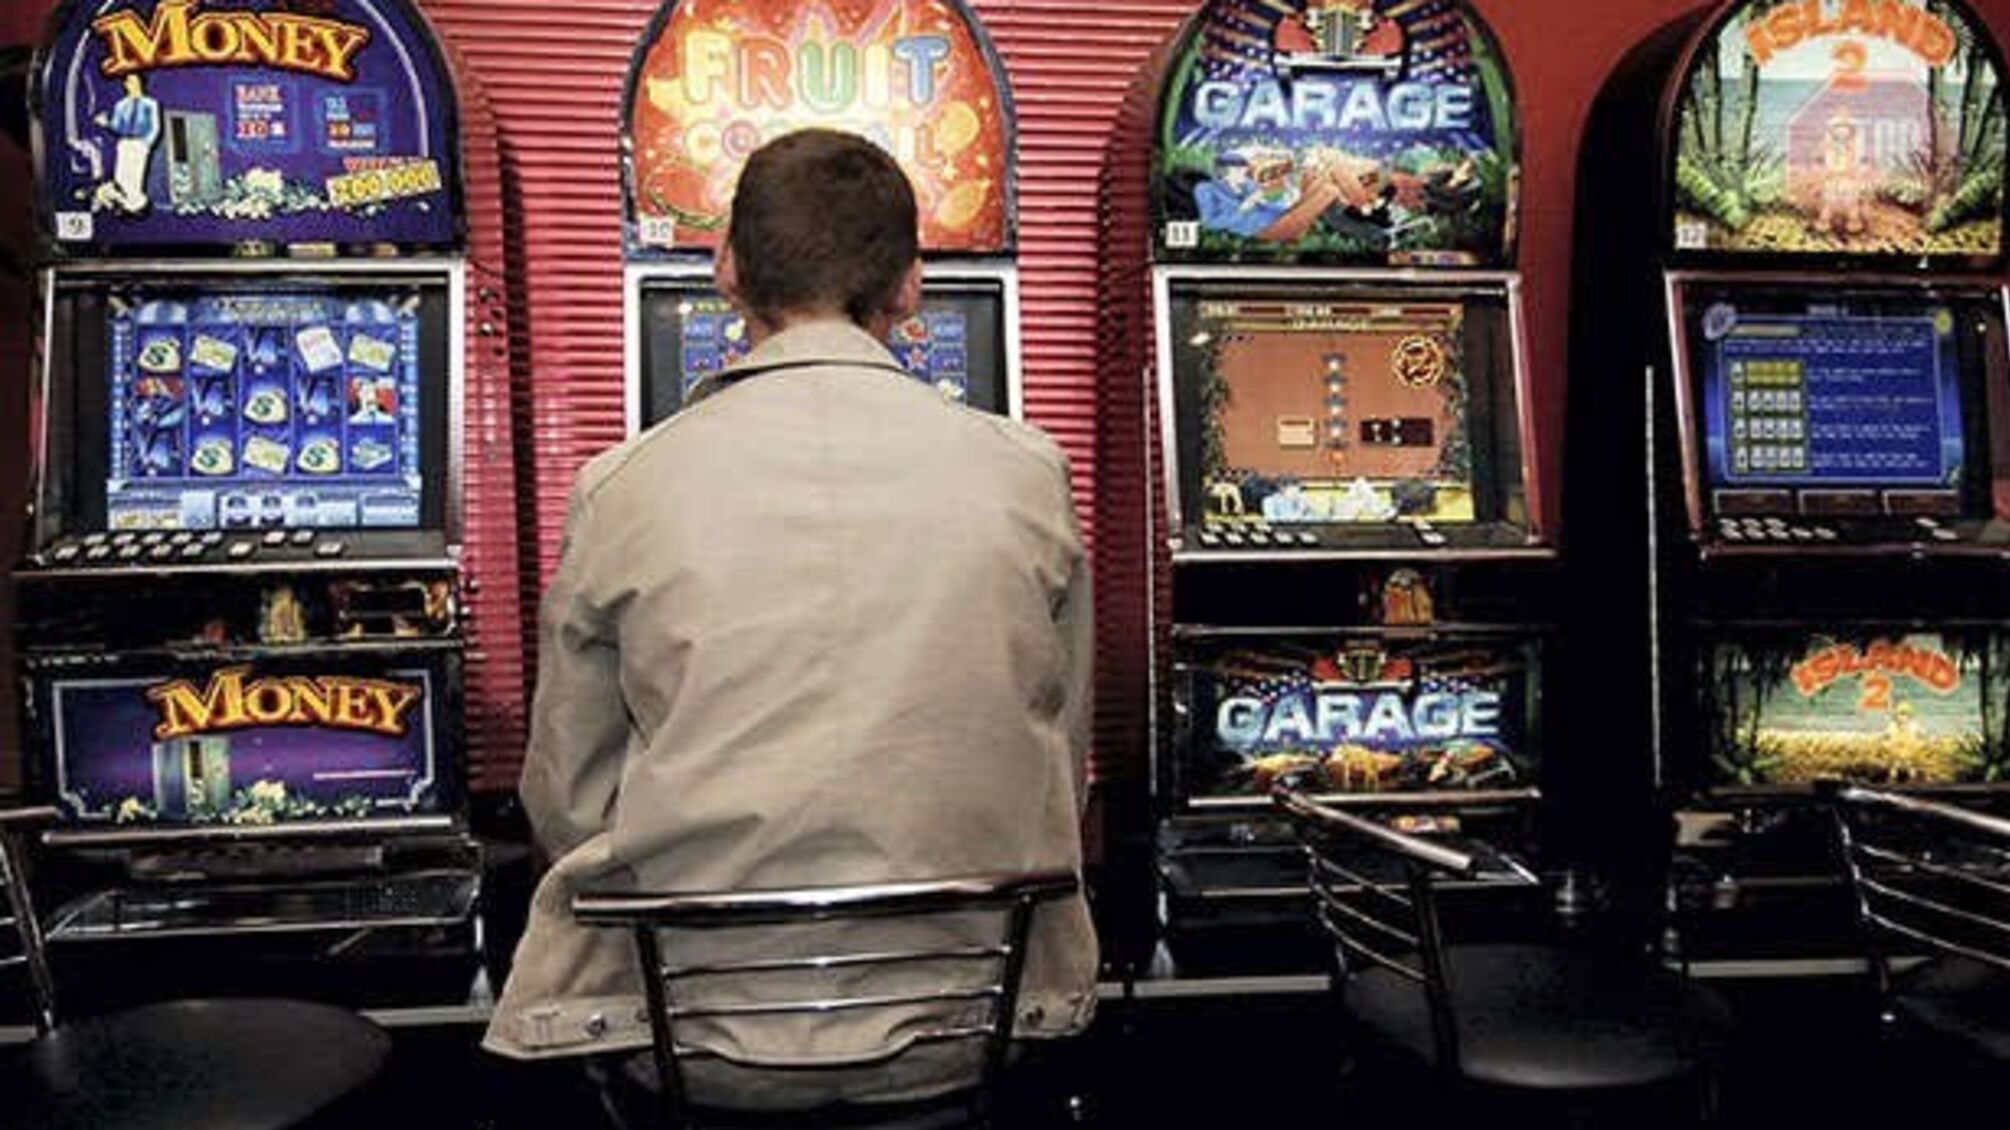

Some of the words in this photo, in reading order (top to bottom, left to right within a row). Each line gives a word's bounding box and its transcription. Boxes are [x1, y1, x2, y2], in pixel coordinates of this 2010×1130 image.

[94, 0, 369, 81] MONEY
[1746, 0, 1956, 67] ISLAND
[684, 28, 949, 112] FRUIT
[1830, 41, 1867, 93] 2
[1194, 80, 1472, 129] GARAGE
[1791, 643, 1960, 697] ISLAND
[1859, 675, 1889, 711] 2
[146, 663, 421, 738] MONEY
[1217, 692, 1499, 746] GARAGE
